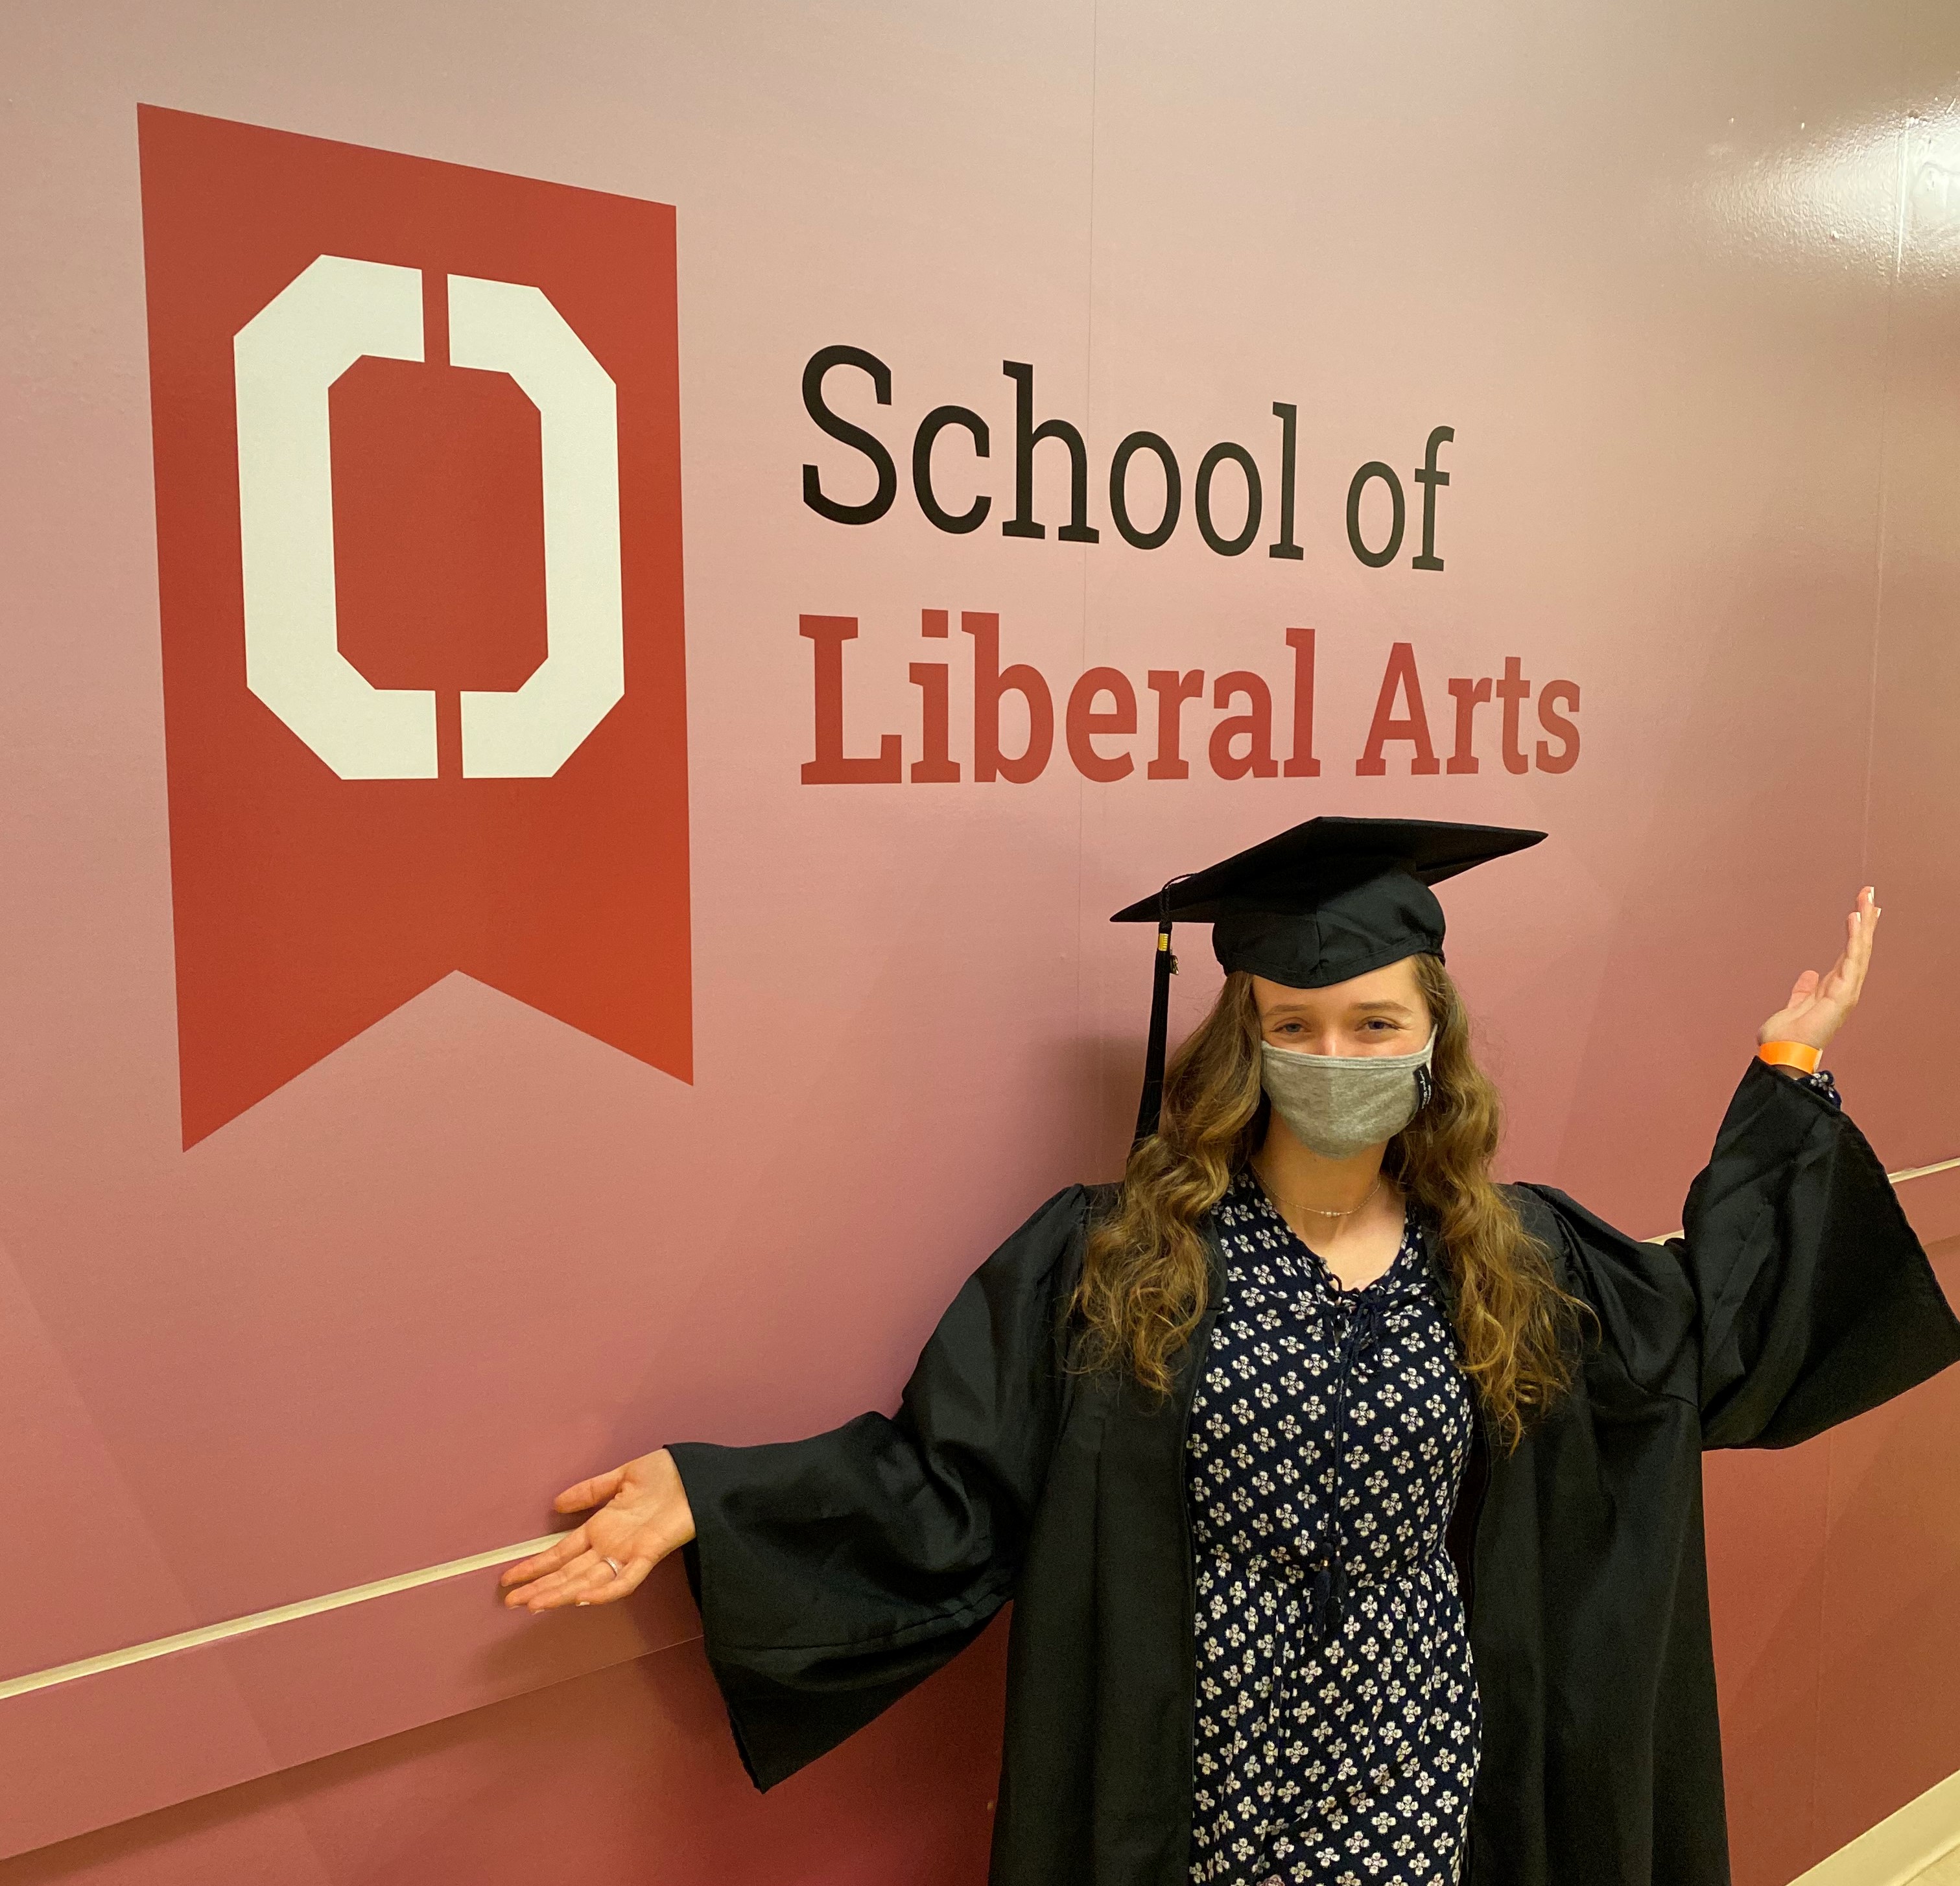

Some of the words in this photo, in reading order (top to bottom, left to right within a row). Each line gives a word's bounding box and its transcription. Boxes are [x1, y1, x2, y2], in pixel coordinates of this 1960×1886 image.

[801, 344, 1304, 561] School
[1346, 425, 1456, 572] of
[799, 609, 1321, 785] Liberal
[1356, 642, 1581, 777] Arts
